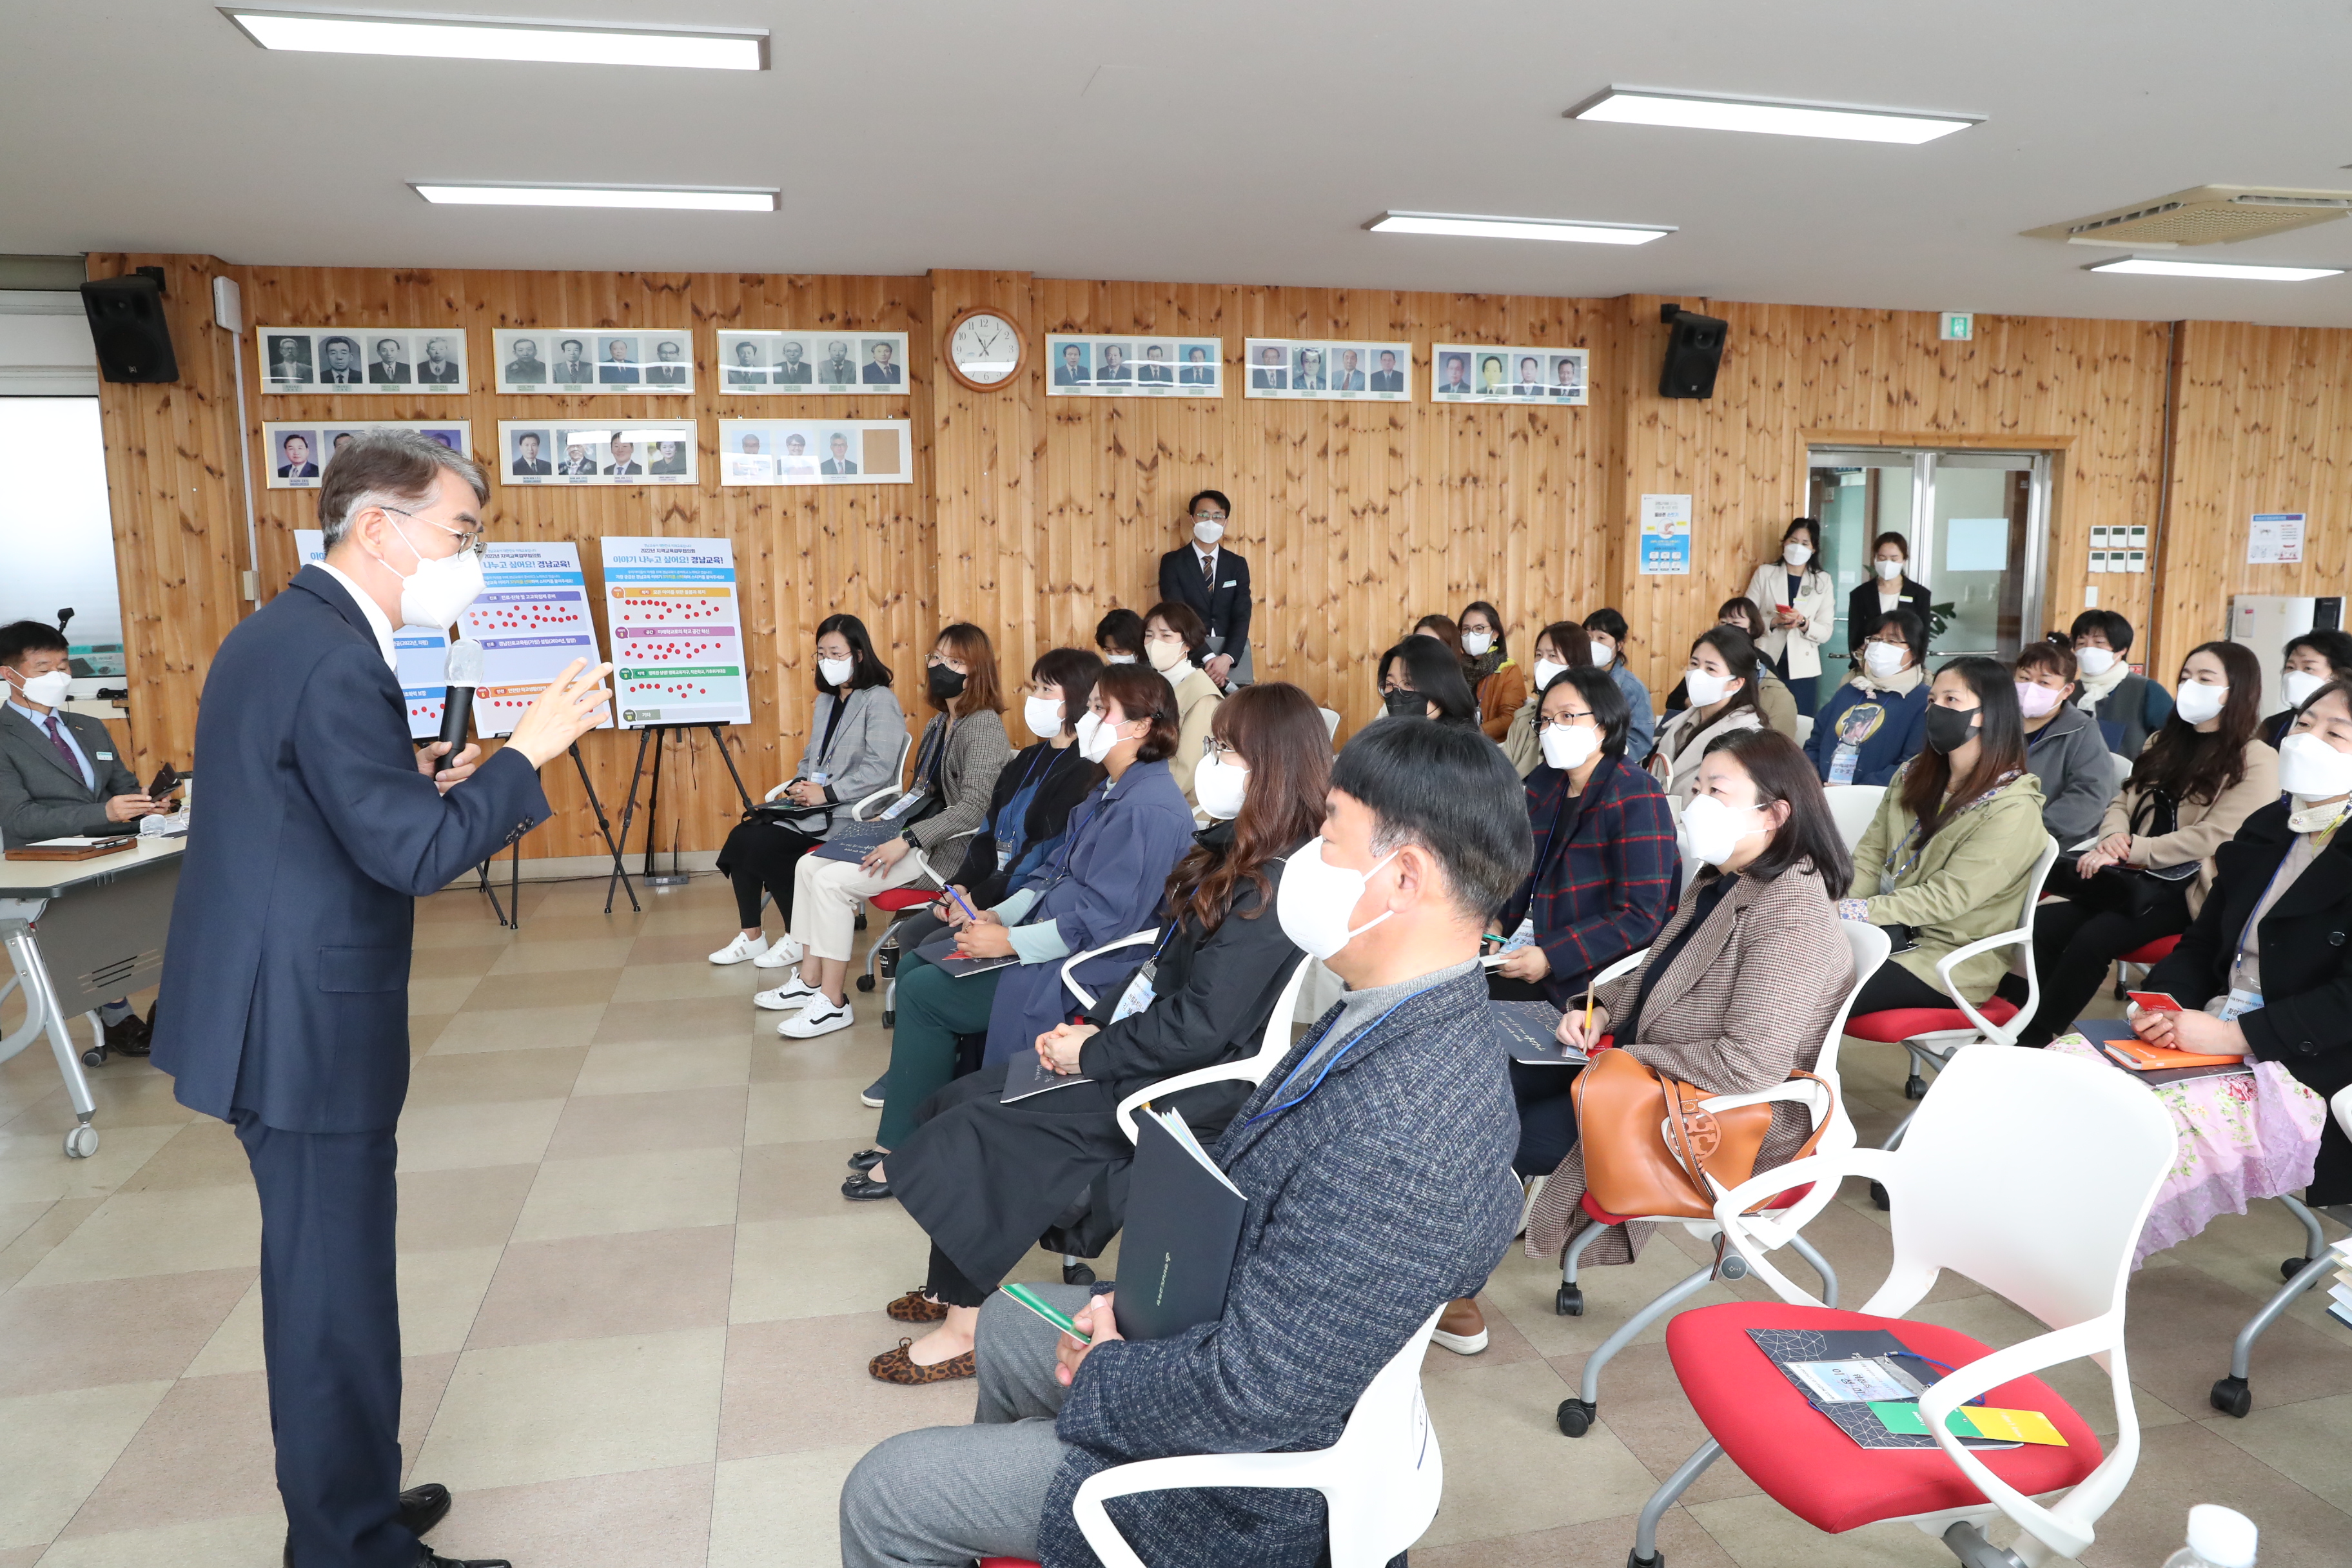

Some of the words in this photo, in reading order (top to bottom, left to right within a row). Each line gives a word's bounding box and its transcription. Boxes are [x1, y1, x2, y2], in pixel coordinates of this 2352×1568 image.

[968, 322, 974, 330] 11
[980, 318, 988, 327] 12
[995, 322, 999, 331] 1
[959, 332, 966, 340] 10
[1004, 331, 1010, 340] 2
[956, 346, 962, 355] 9
[984, 372, 989, 380] 6
[639, 556, 662, 564] 나누고
[663, 556, 690, 564] 싶어요!
[691, 556, 723, 564] 경남교육!
